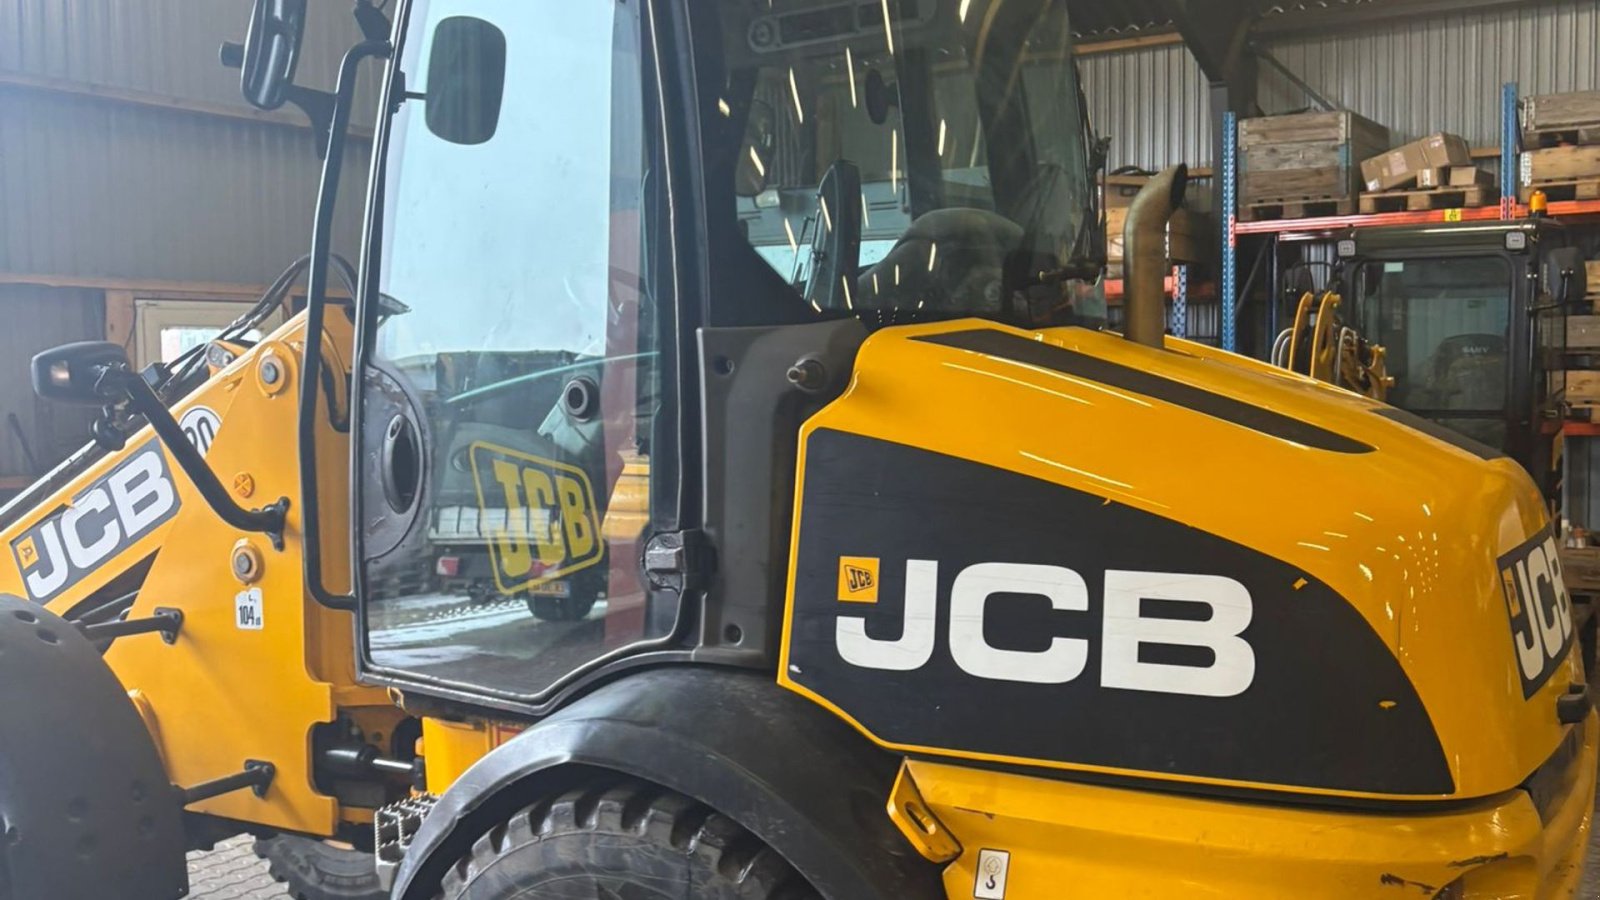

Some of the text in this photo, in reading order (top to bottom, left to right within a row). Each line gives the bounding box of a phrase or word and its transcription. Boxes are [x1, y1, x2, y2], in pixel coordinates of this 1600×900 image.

[26, 451, 174, 598] JCB
[493, 460, 595, 578] JCB
[238, 605, 255, 625] 104
[835, 558, 1256, 698] JCB
[850, 568, 872, 589] JCB
